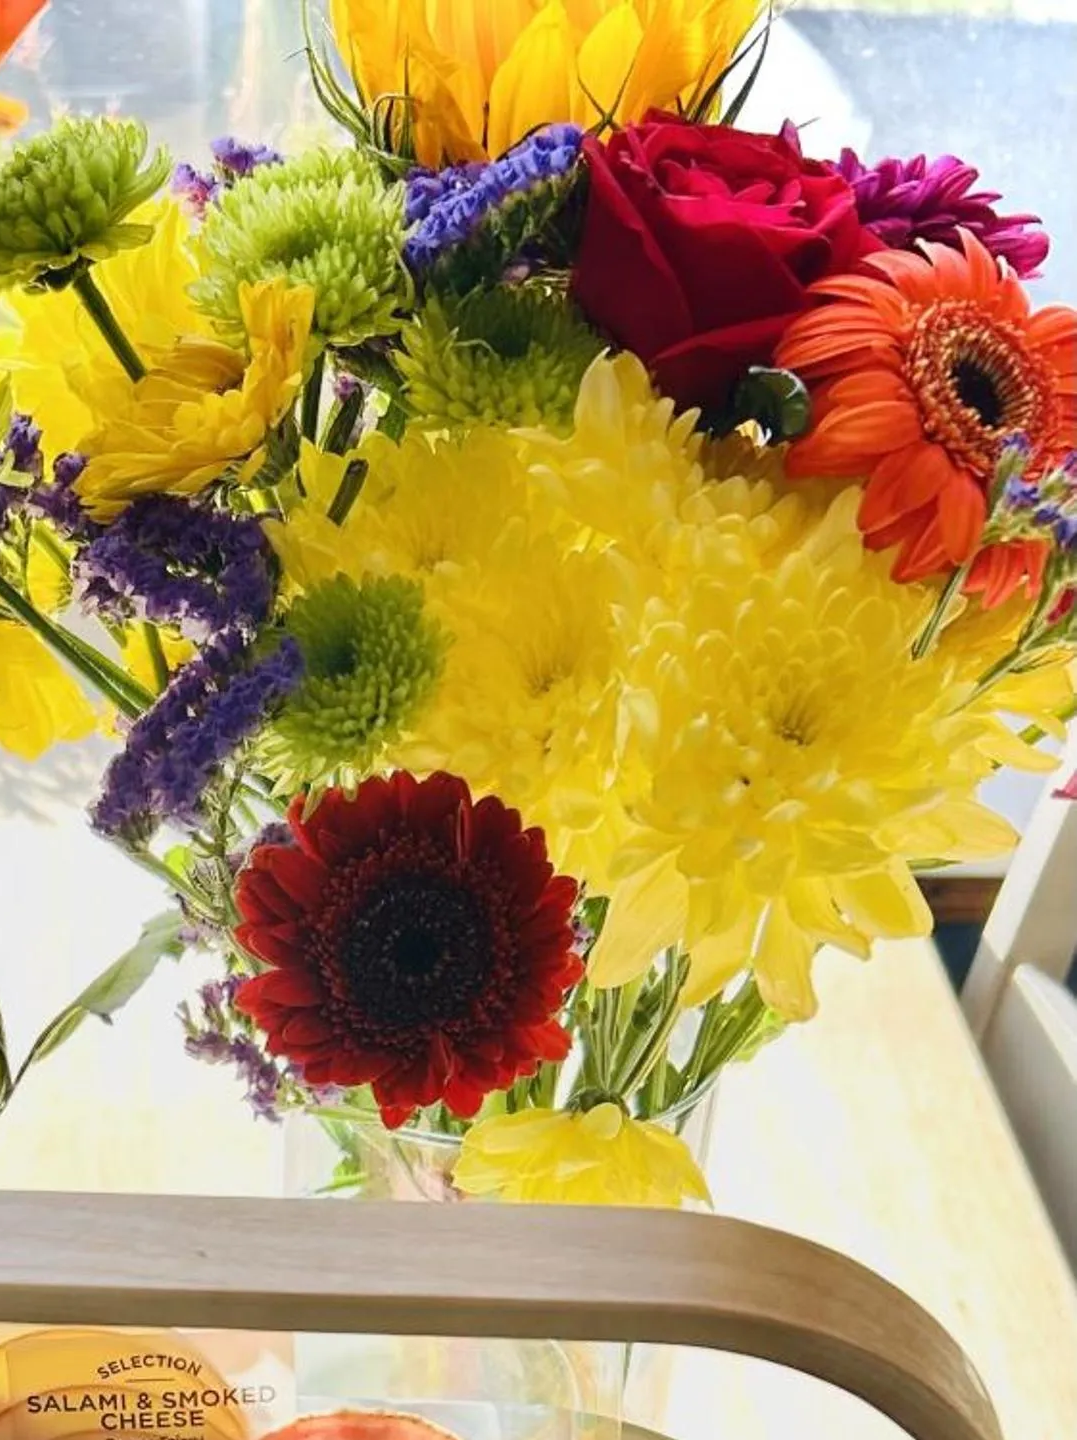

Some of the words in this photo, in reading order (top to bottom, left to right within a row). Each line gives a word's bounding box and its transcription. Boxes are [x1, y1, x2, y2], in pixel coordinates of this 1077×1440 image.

[97, 1354, 202, 1379] SELECTION
[27, 1393, 126, 1413] SALAMI
[137, 1392, 152, 1410] &
[162, 1385, 276, 1409] SMOKED
[101, 1409, 205, 1430] CHEESE
